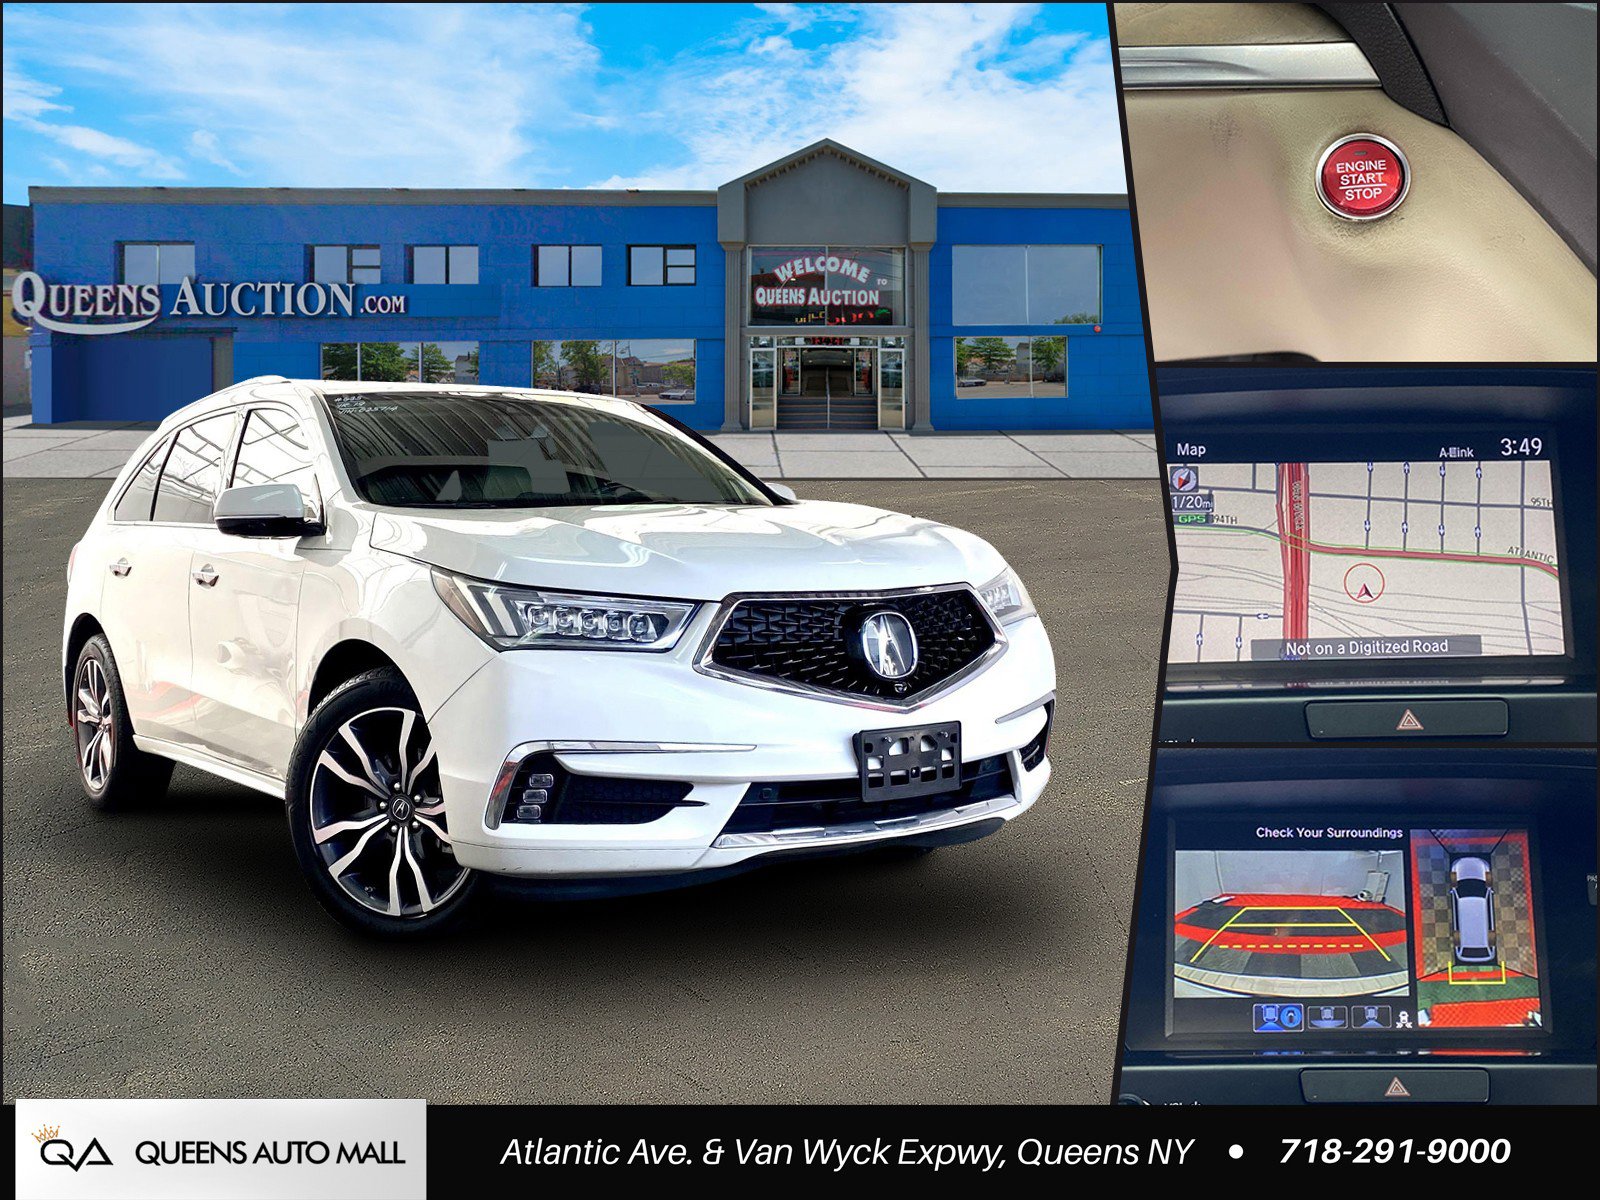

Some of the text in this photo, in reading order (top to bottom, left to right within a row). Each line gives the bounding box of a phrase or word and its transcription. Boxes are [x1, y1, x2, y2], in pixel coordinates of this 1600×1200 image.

[1336, 160, 1387, 173] ENGINE
[1340, 172, 1384, 185] START
[1345, 188, 1382, 201] STOP
[774, 256, 888, 286] WELCOME TO
[12, 271, 161, 335] QUEENS
[169, 276, 356, 316] AUCTION
[755, 287, 880, 307] QUEENS AUCTION
[1176, 442, 1206, 457] Map
[1500, 437, 1542, 456] 3:49
[1178, 514, 1206, 523] GPS
[1507, 546, 1554, 564] ATLANTIC
[1286, 639, 1449, 656] Not on a Digitized Road
[1256, 826, 1403, 839] Check Your Surroundings
